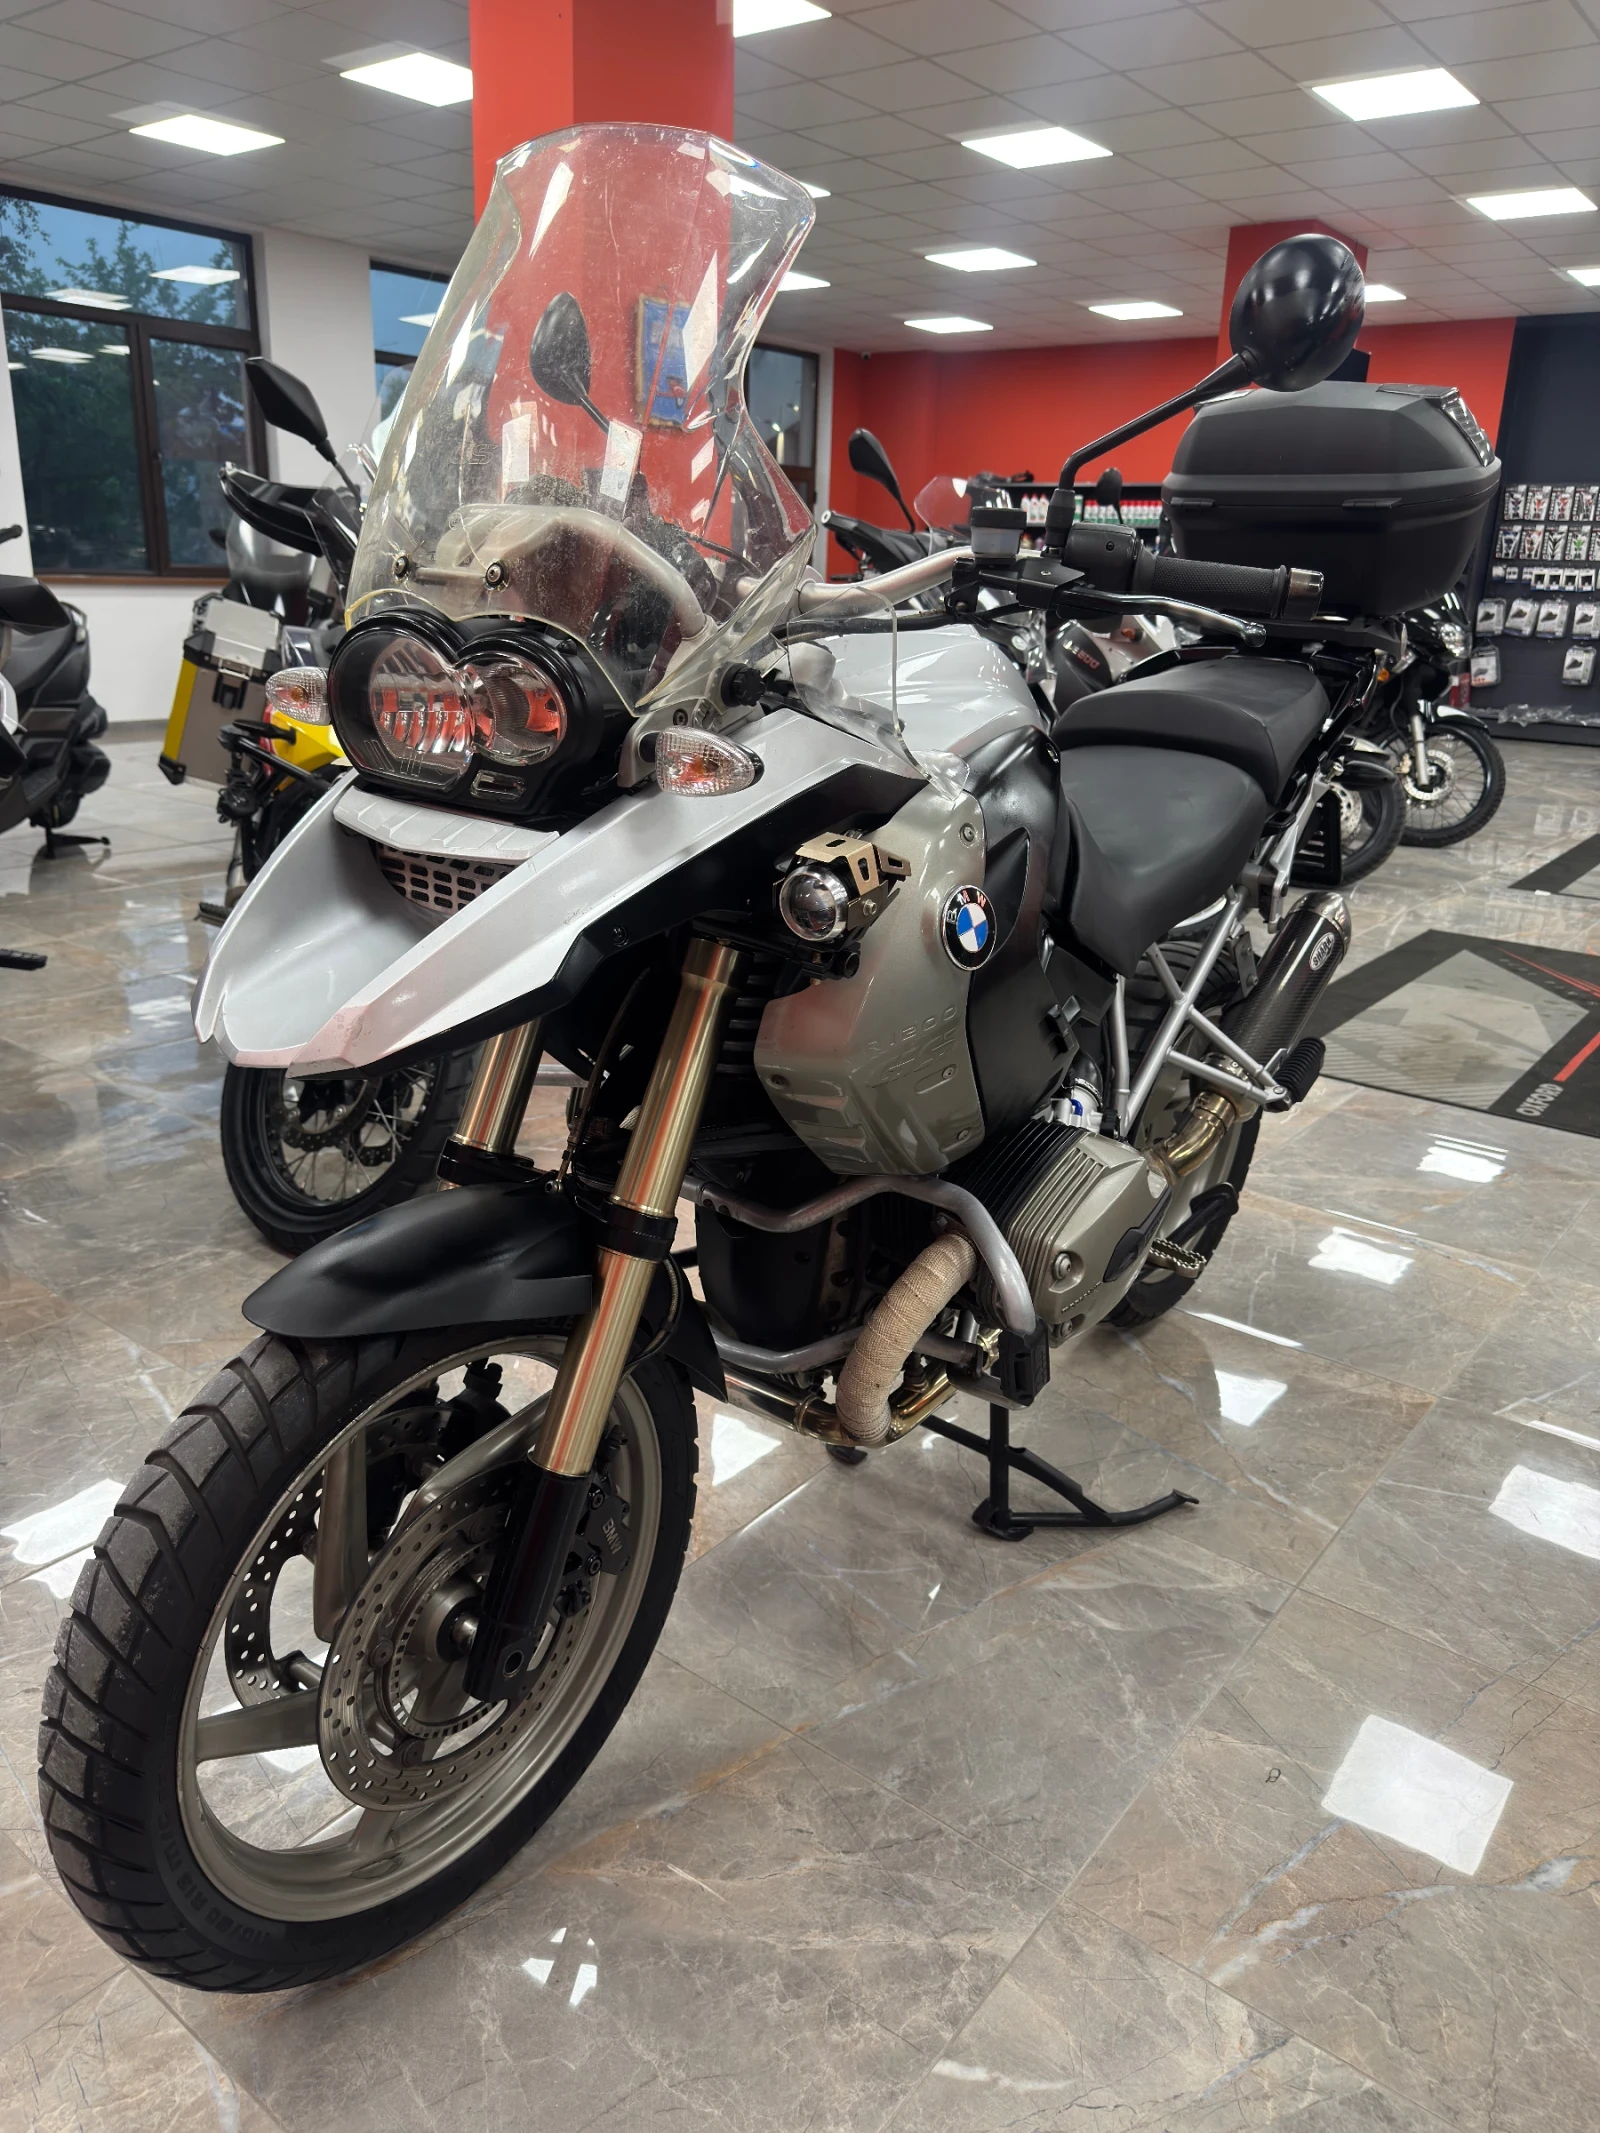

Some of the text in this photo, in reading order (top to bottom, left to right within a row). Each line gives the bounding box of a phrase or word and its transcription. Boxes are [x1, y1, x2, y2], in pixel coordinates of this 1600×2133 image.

[1312, 936, 1333, 967] SHARK
[1515, 1083, 1564, 1117] OXFORD
[602, 1517, 623, 1555] BMW
